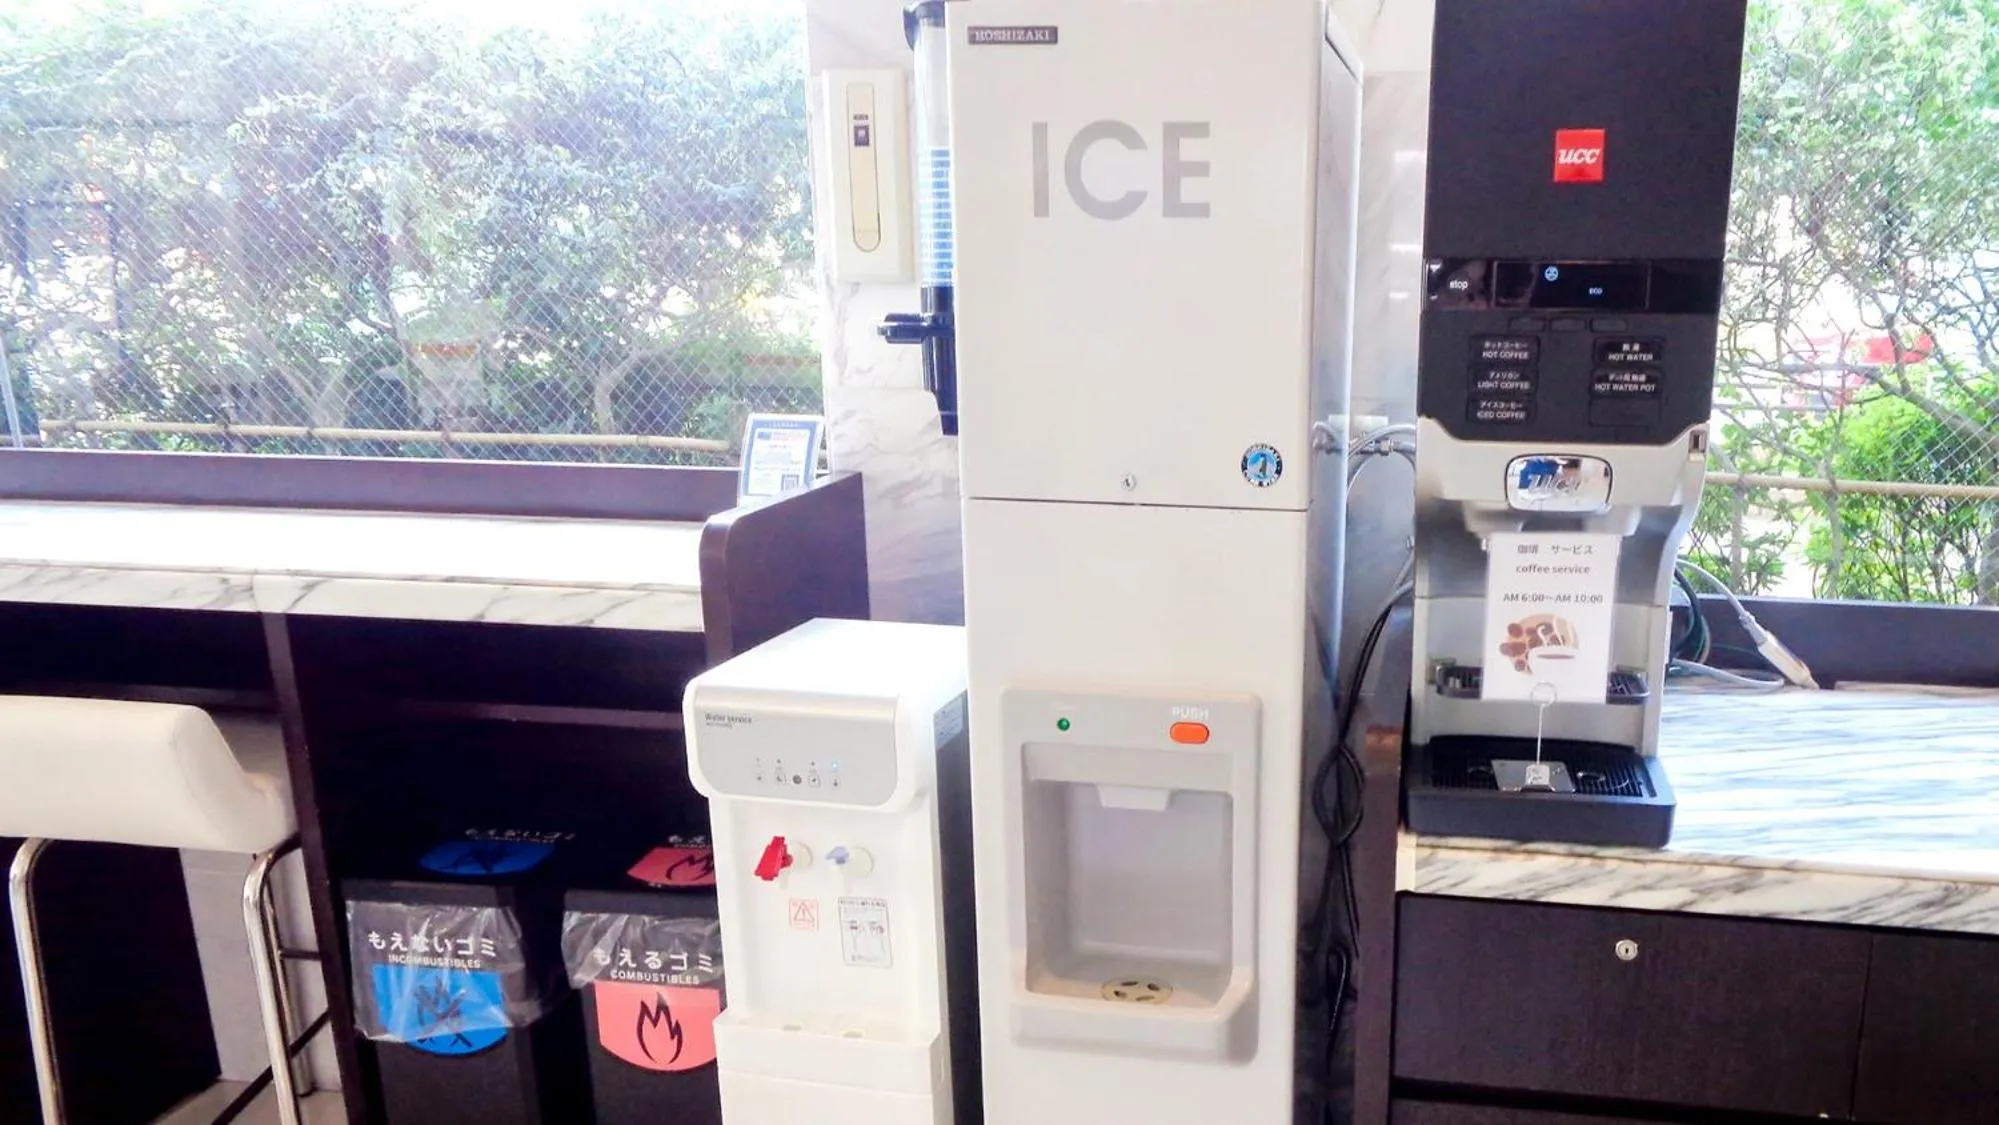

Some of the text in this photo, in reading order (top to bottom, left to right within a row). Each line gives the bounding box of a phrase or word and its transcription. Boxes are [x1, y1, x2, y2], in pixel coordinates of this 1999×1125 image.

[975, 30, 1051, 41] HOSHIZAKI
[1032, 119, 1210, 221] ICE
[1449, 279, 1468, 290] stop
[1482, 351, 1529, 360] HOT COFFEE
[1608, 353, 1653, 361] HOT WATER
[1477, 381, 1530, 390] LIGHT COFFEE
[1594, 383, 1656, 392] HOT WATER POT
[1476, 410, 1526, 420] ICED COFFEE
[1550, 544, 1594, 555] サービス
[1516, 564, 1591, 574] coffee service
[1503, 593, 1519, 602] AM
[1574, 594, 1603, 603] 10:00
[1172, 705, 1210, 720] PUSH
[367, 930, 496, 957] もえないゴミ
[388, 955, 481, 969] INCOMBUSTIBLES
[594, 947, 713, 973] もえるゴミ
[611, 969, 700, 985] COMBUSTIBLES
